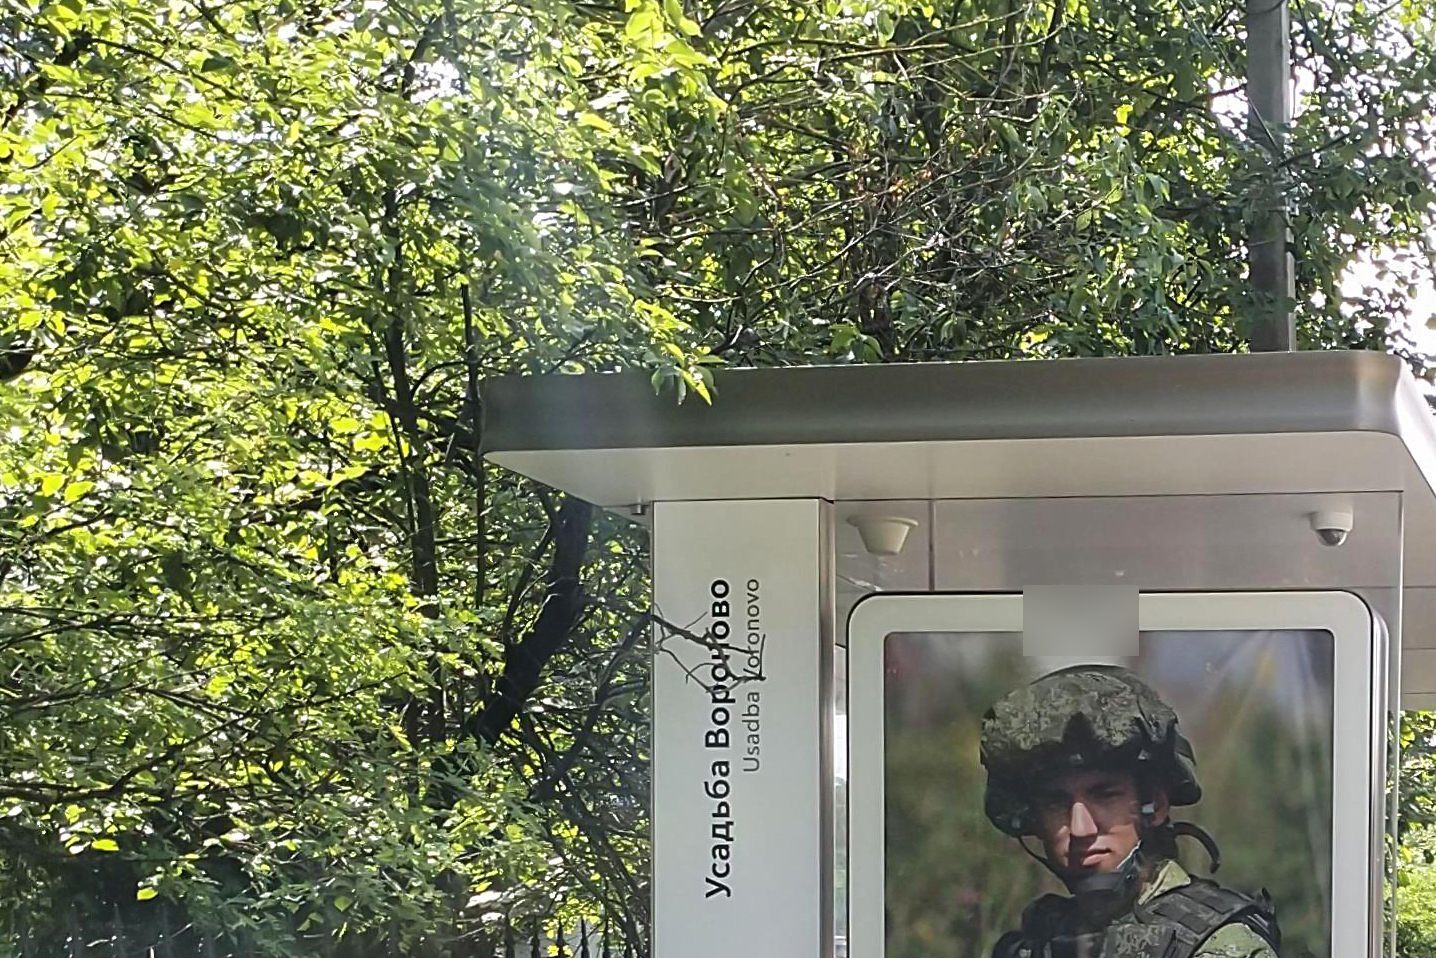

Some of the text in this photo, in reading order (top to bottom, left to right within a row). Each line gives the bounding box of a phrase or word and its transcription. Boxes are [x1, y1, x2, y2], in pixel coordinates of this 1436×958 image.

[704, 578, 736, 898] Усадьба Вороново
[742, 691, 760, 773] Usadba
